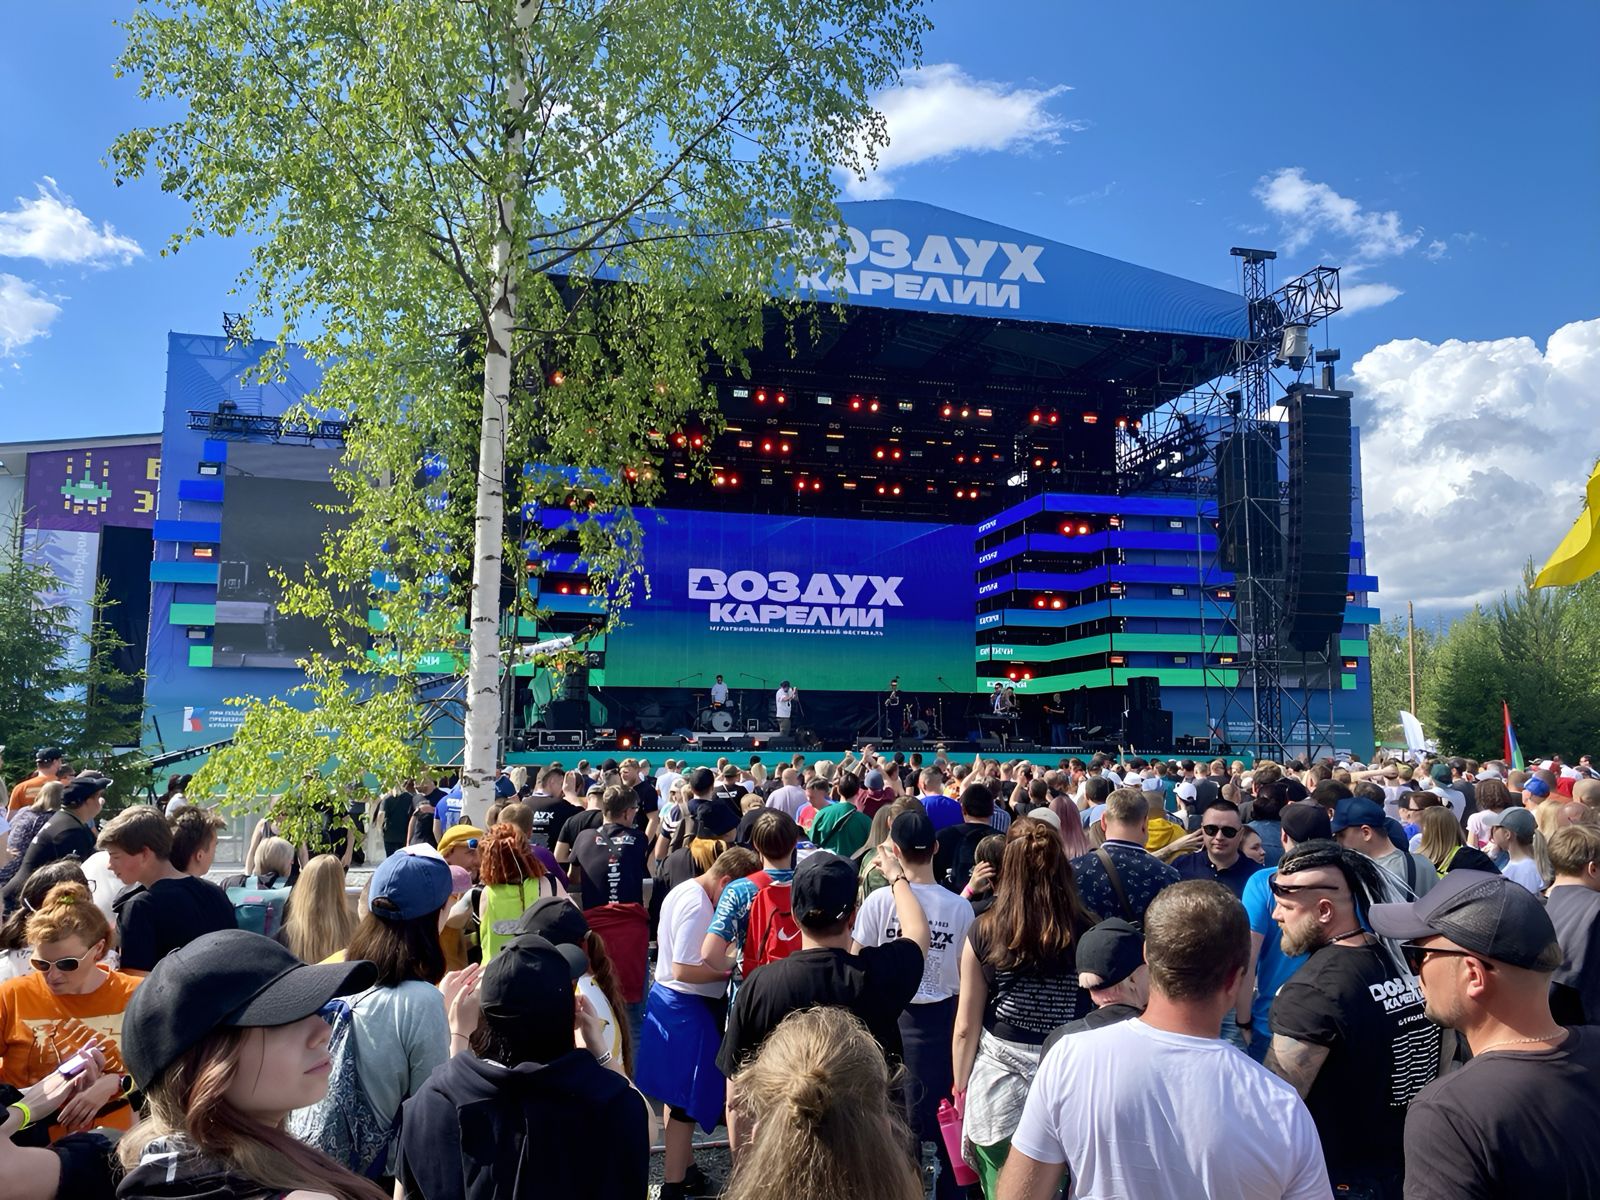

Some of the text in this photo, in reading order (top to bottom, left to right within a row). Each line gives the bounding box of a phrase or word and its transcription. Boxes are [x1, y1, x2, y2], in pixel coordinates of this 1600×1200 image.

[688, 567, 904, 607] ВОЗДУХ
[709, 602, 884, 628] КАРЕЛИИ
[842, 629, 884, 637] ФЕСТИВАЛЬ
